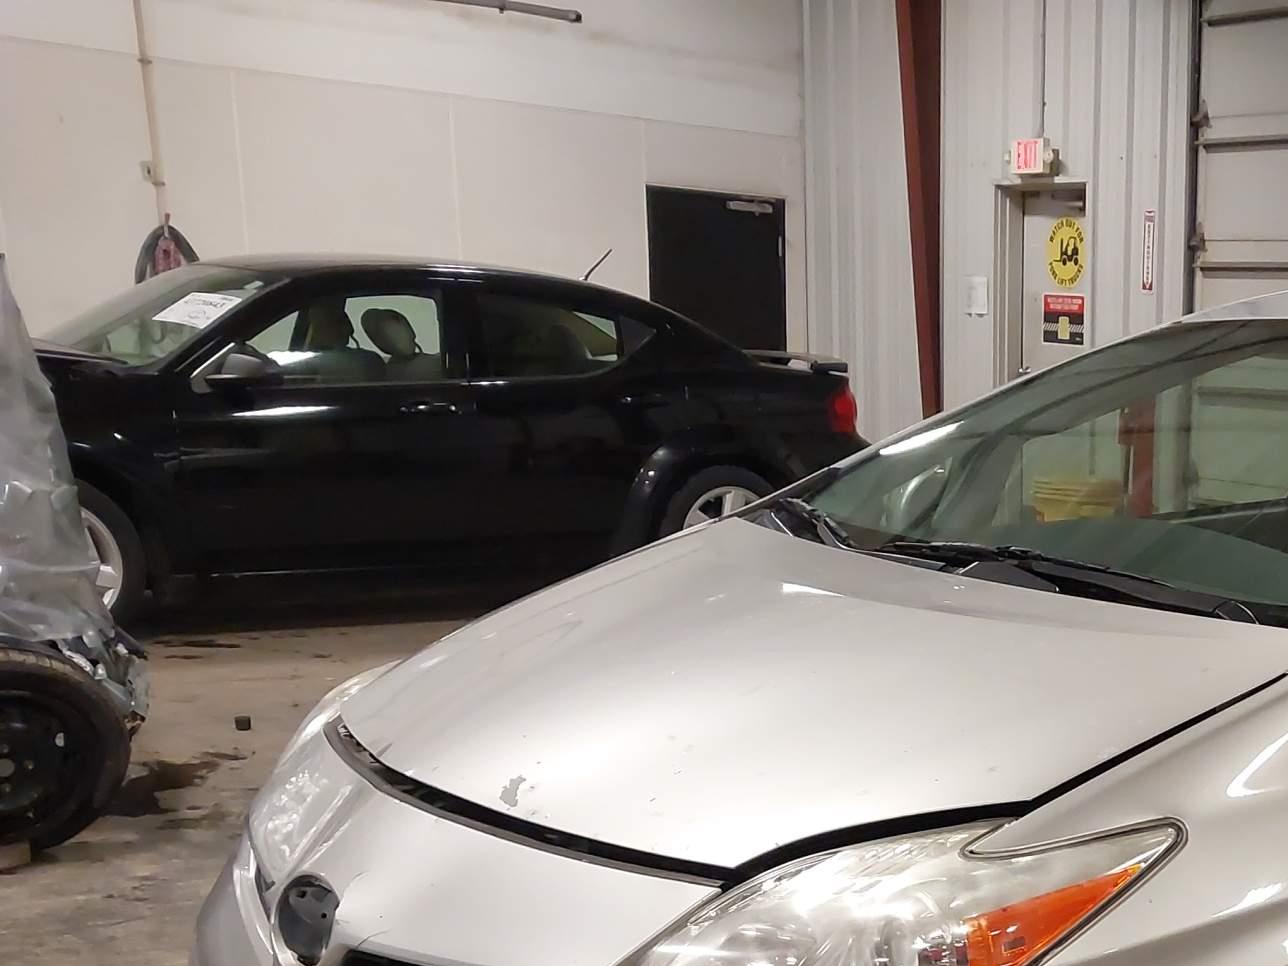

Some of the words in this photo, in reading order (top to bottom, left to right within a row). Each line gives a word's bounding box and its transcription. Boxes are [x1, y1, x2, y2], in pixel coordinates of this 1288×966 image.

[1017, 140, 1038, 169] EXIT
[1049, 219, 1065, 243] WATCH
[1065, 218, 1076, 229] OUT
[1075, 226, 1084, 244] FOR
